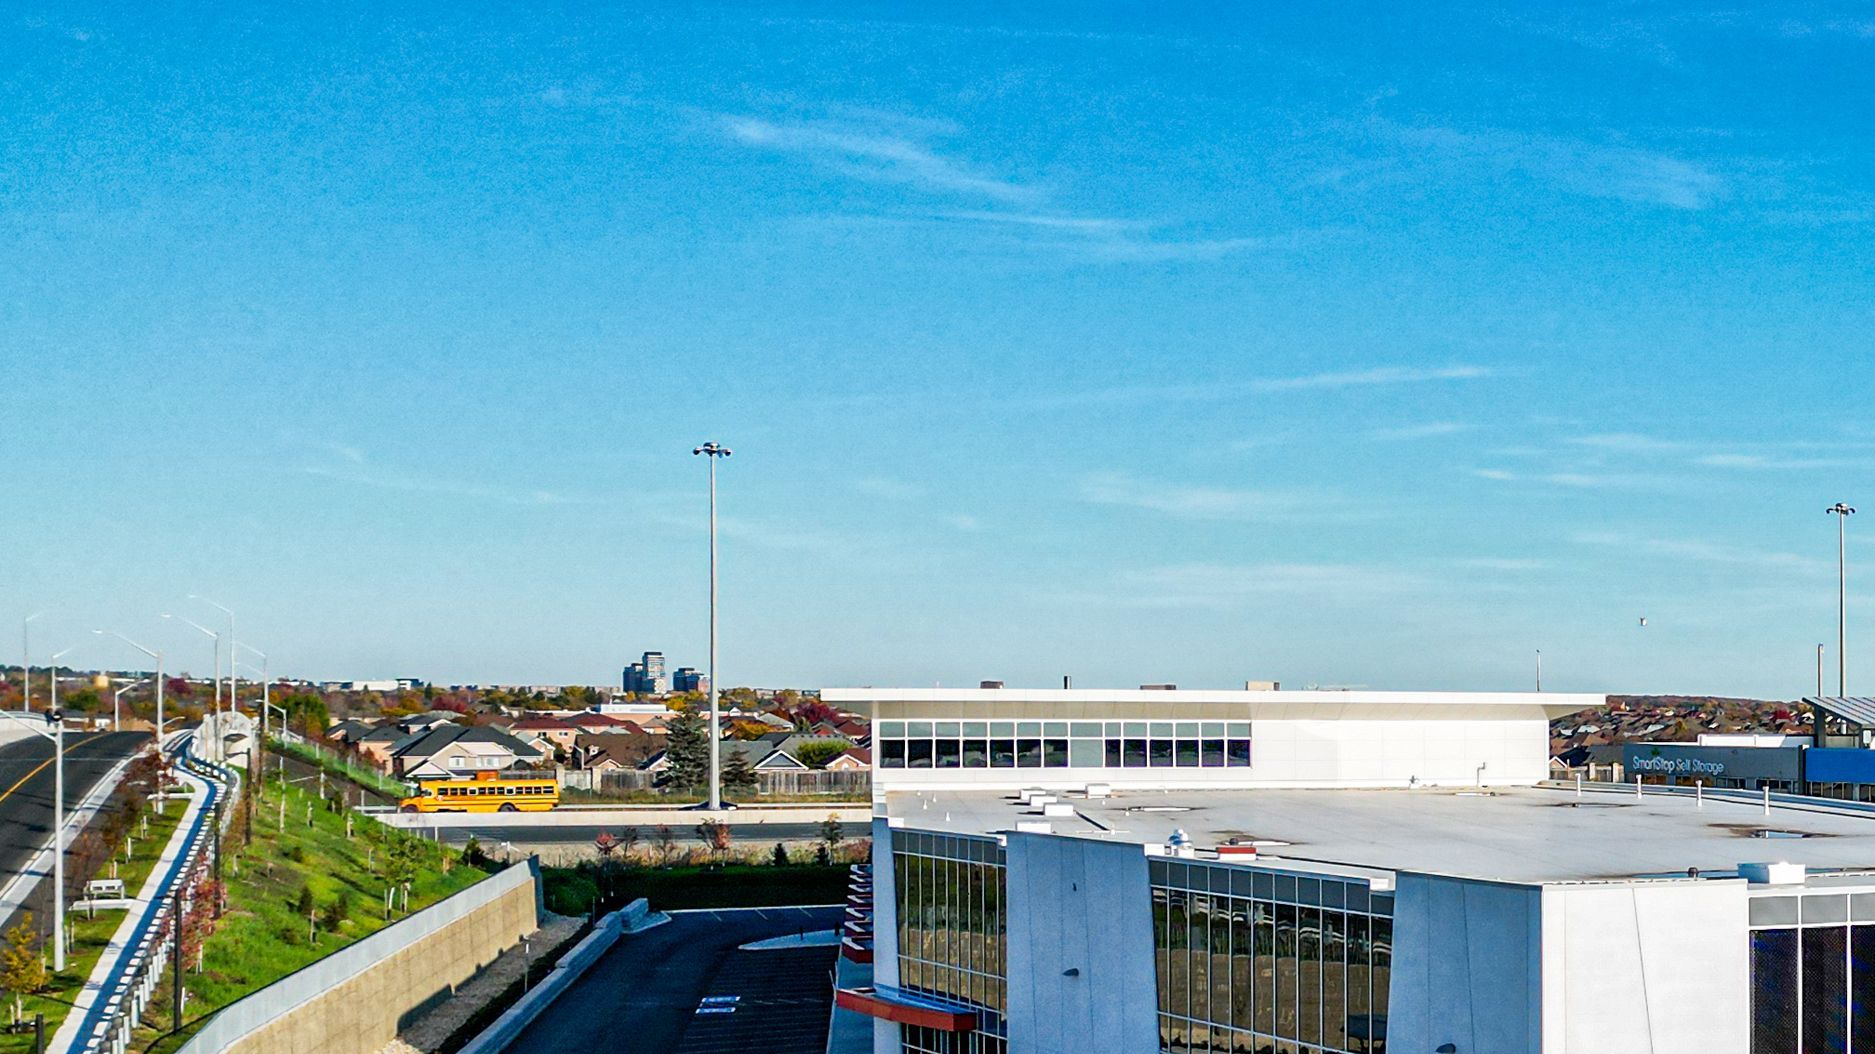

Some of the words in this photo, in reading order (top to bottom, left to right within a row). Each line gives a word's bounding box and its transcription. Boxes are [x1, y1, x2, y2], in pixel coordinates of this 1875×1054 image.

[1632, 755, 1675, 774] SmartStop
[1676, 759, 1691, 771] Self
[1692, 759, 1724, 775] Storage
